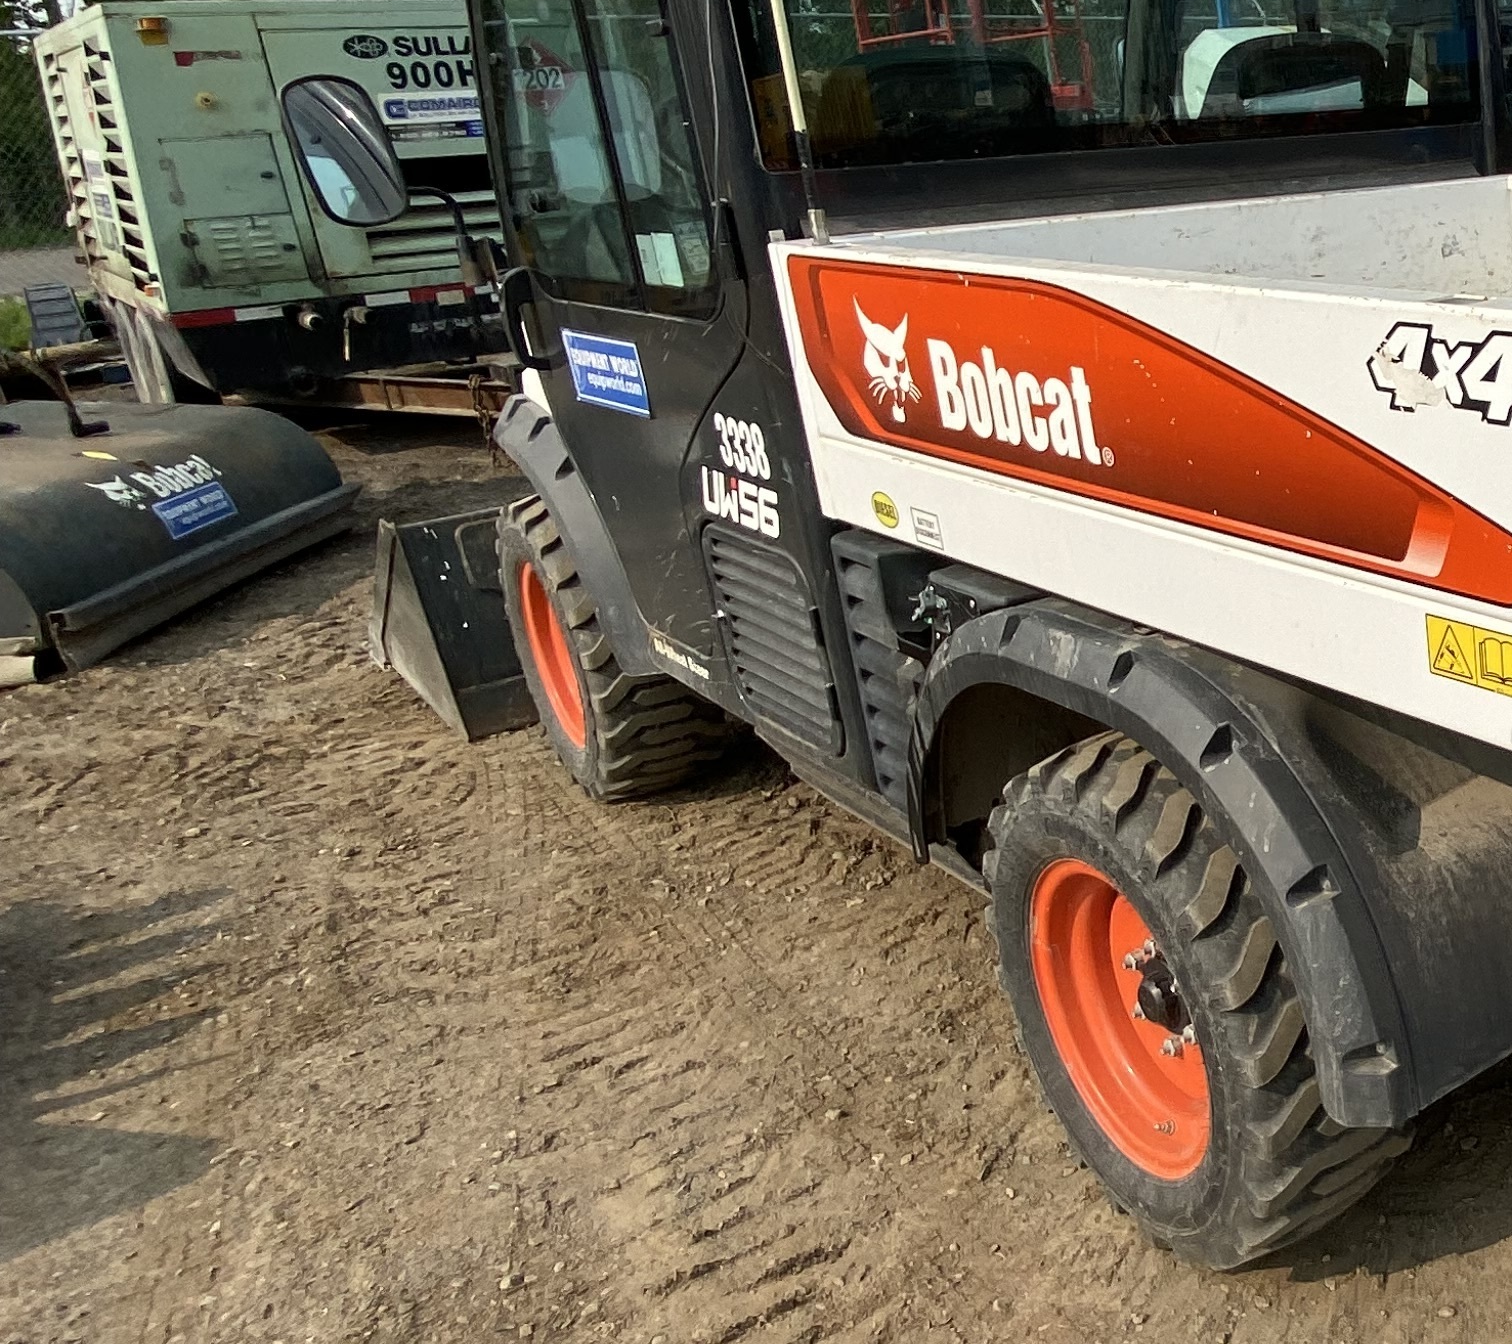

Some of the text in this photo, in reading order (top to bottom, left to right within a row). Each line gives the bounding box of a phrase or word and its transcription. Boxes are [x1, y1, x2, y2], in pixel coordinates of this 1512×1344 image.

[608, 355, 639, 378] WORLD
[926, 338, 1102, 466] Bobcat
[713, 412, 772, 481] 3338
[701, 465, 780, 539] UW56
